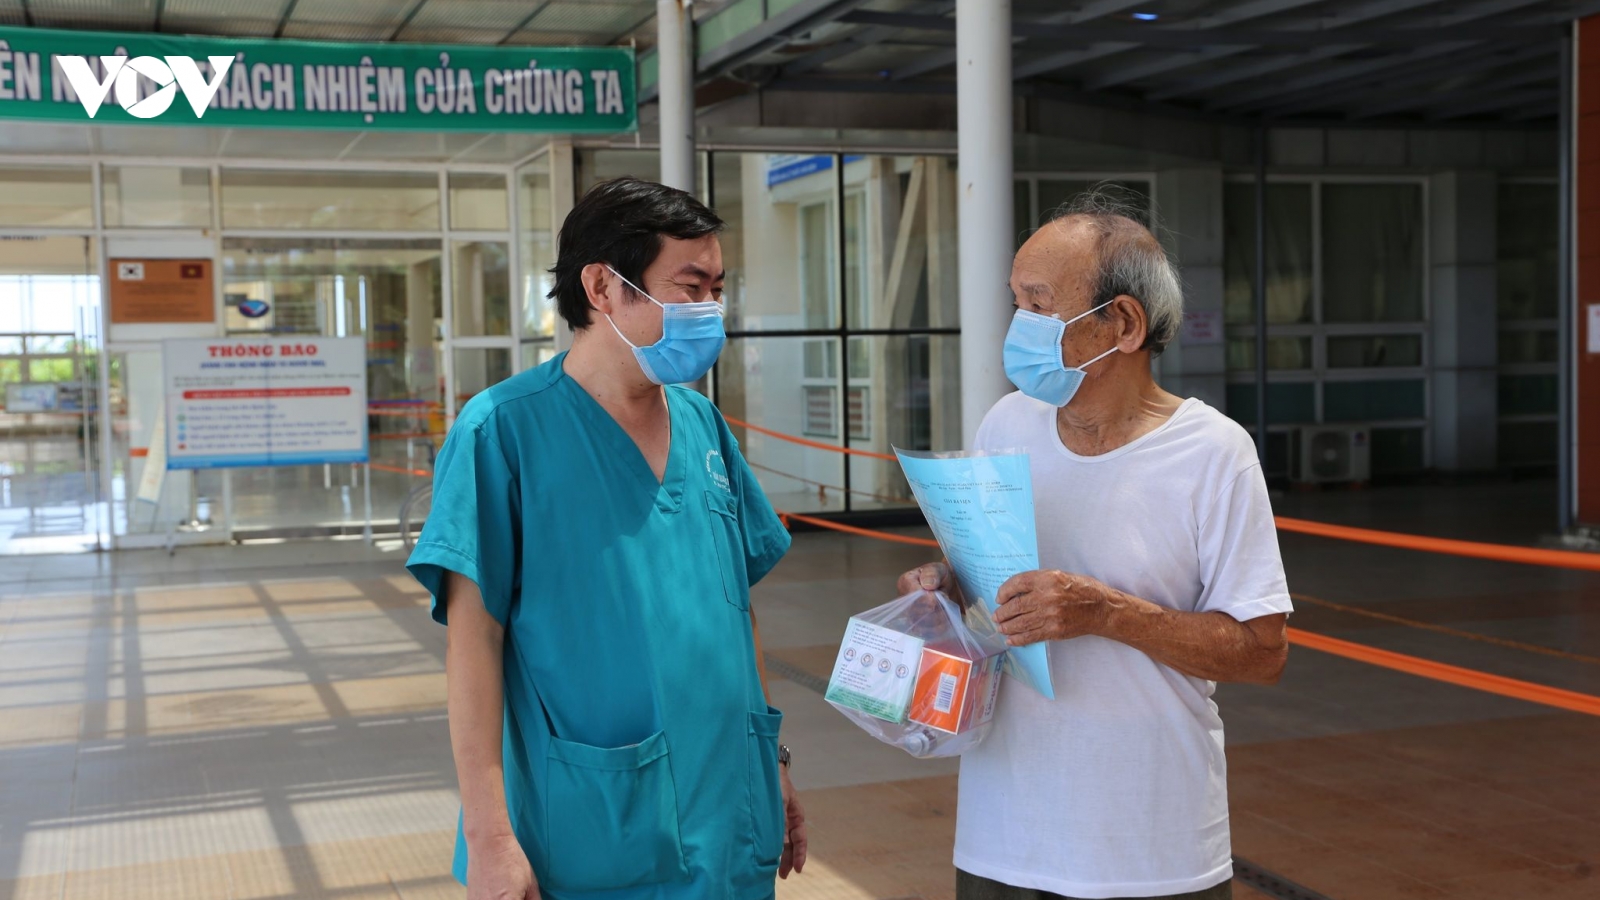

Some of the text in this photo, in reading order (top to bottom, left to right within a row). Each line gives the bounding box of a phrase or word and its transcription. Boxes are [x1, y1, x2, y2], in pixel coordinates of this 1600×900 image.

[303, 56, 406, 123] NHIỆM
[415, 52, 476, 114] CỦA
[485, 59, 584, 115] CHÚNG
[591, 69, 624, 115] TA
[207, 342, 318, 358] THÔNG BÁO
